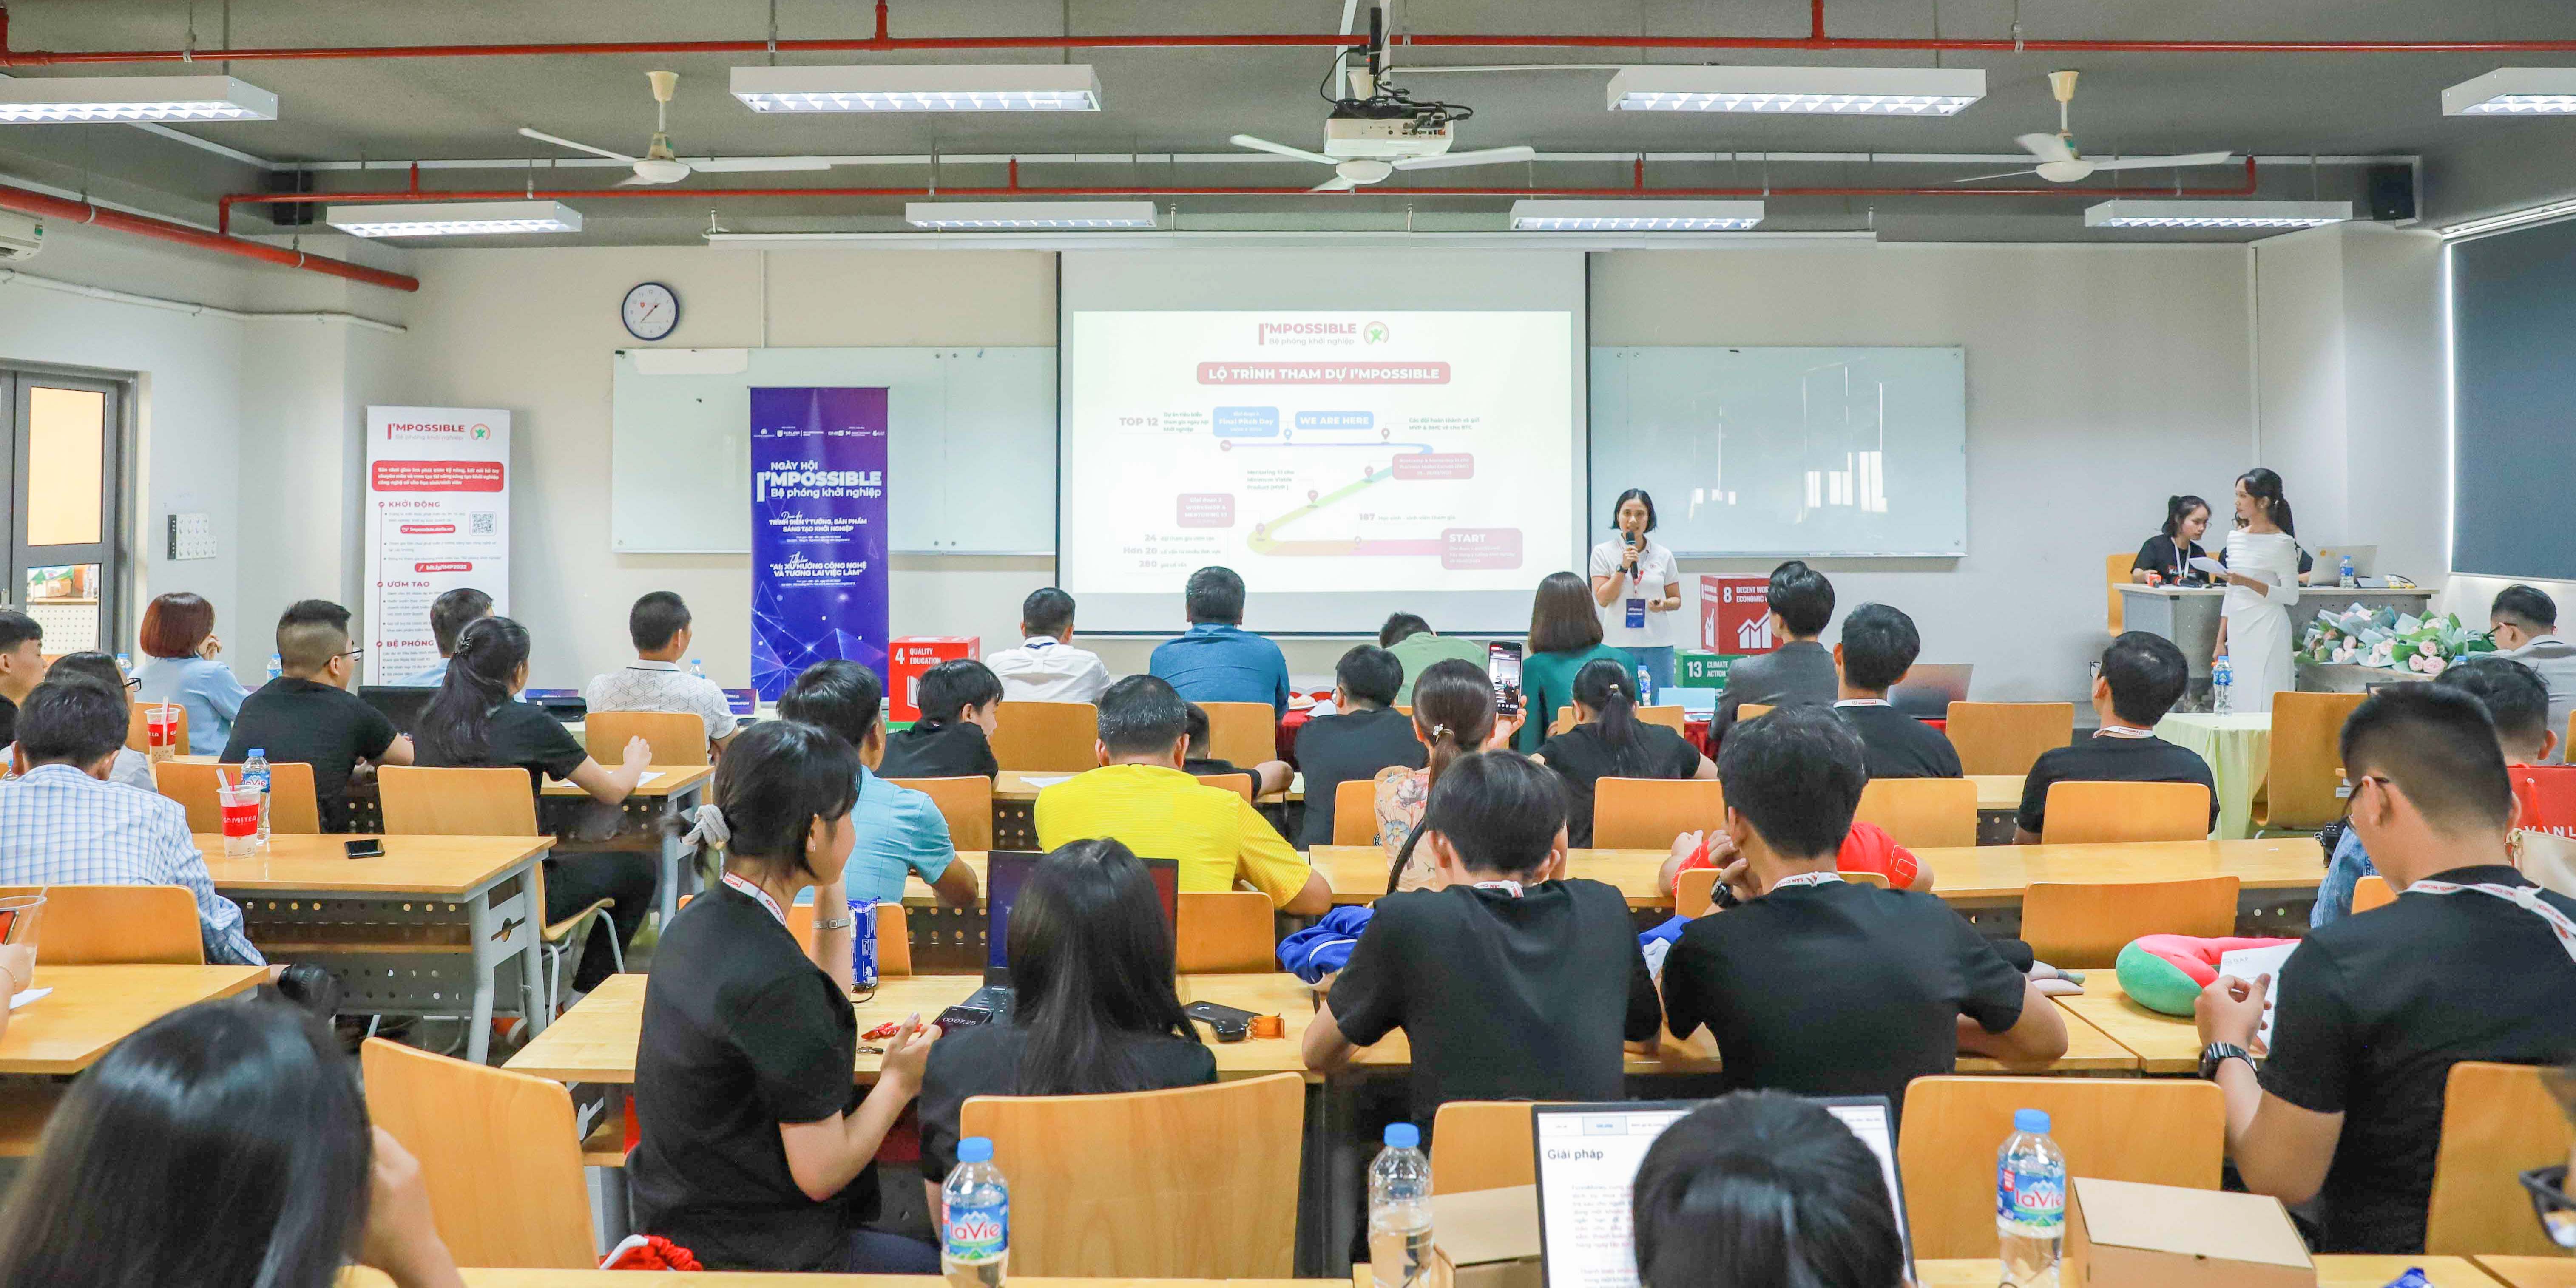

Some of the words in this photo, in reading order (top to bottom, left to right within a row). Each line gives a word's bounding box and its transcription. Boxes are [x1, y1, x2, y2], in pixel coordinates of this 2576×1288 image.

[1258, 323, 1357, 346] I'MPOSSIBLE
[1281, 337, 1306, 346] phóng
[1209, 366, 1227, 382] LỘ
[1232, 366, 1275, 379] TRÌNH
[1280, 369, 1321, 379] THAM
[1325, 367, 1347, 383] DỰ
[1350, 369, 1439, 379] I'MPOSSIBLE
[1119, 417, 1143, 426] TOP
[1147, 417, 1158, 426] 12
[1300, 417, 1317, 425] WE
[1320, 417, 1340, 425] ARE
[1343, 417, 1369, 425] HERE
[388, 423, 466, 440] I'MPOSSIBLE
[770, 460, 798, 471] NGÀY
[801, 460, 818, 471] HỘI
[756, 471, 882, 502] I'MPOSSIBLE
[787, 488, 820, 499] phóng
[822, 487, 843, 496] khởi
[846, 488, 881, 499] nghiệp
[414, 500, 440, 508] ĐỘNG
[1449, 534, 1485, 542] START
[1723, 586, 1732, 603] 8
[387, 639, 398, 649] BỆ
[402, 639, 434, 647] PHÓNG
[895, 647, 905, 665] 4
[1687, 661, 1703, 678] 13
[1707, 661, 1728, 669] CLIMATE
[1548, 1149, 1571, 1160] Giải
[1574, 1149, 1604, 1161] pháp
[2015, 1189, 2063, 1208] laVie
[950, 1221, 1001, 1240] laVie
